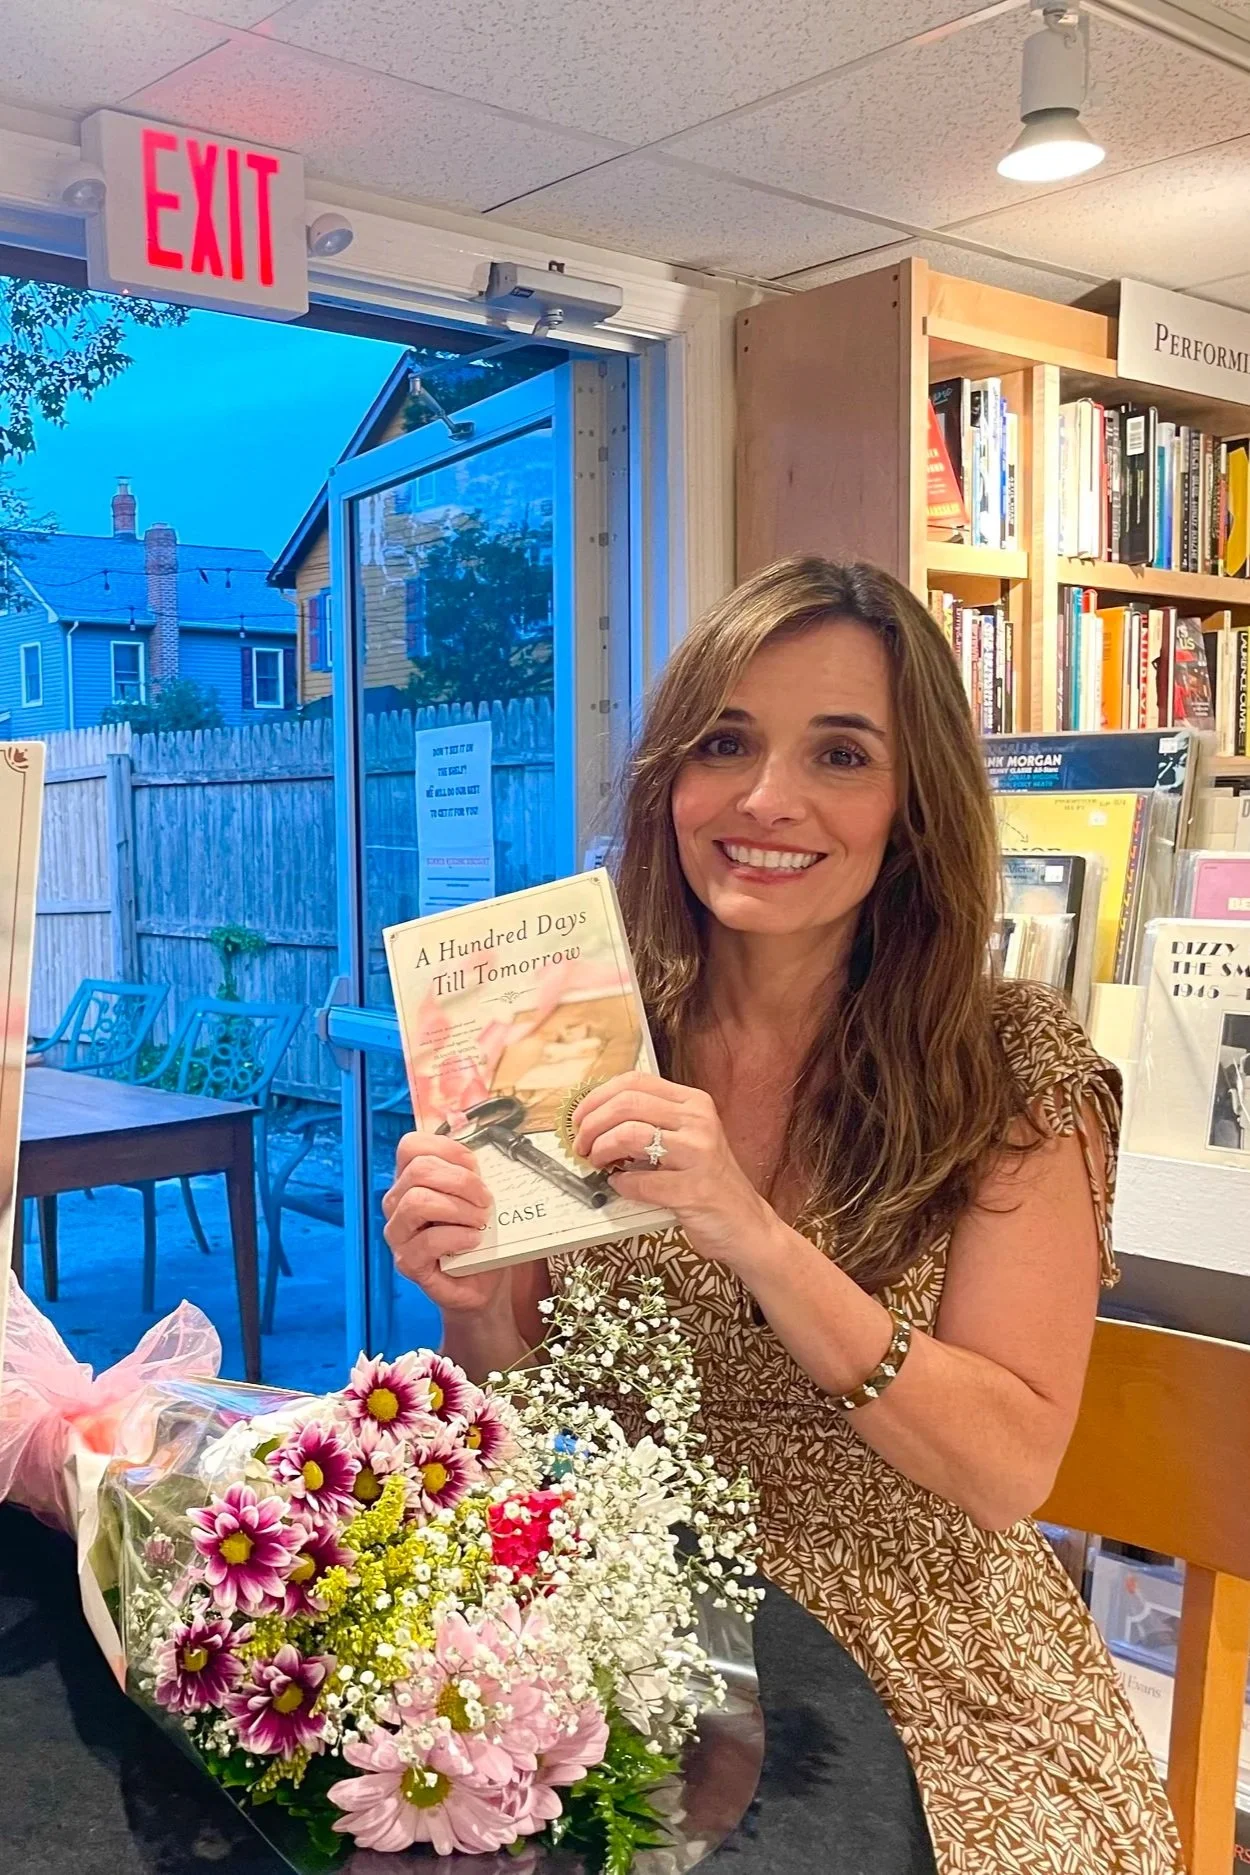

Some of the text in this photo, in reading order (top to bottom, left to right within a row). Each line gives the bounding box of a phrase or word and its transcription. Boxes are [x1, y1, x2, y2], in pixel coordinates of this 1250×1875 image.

[142, 128, 279, 286] EXIT
[1007, 754, 1062, 768] MORGAN
[415, 911, 587, 969] A Hundred Days
[1171, 941, 1240, 957] DIZZY
[432, 946, 581, 996] Till Tomorrow
[1170, 961, 1212, 976] THE
[1173, 983, 1220, 999] 1945
[497, 1203, 547, 1226] CASE
[1127, 1674, 1162, 1699] Evans
